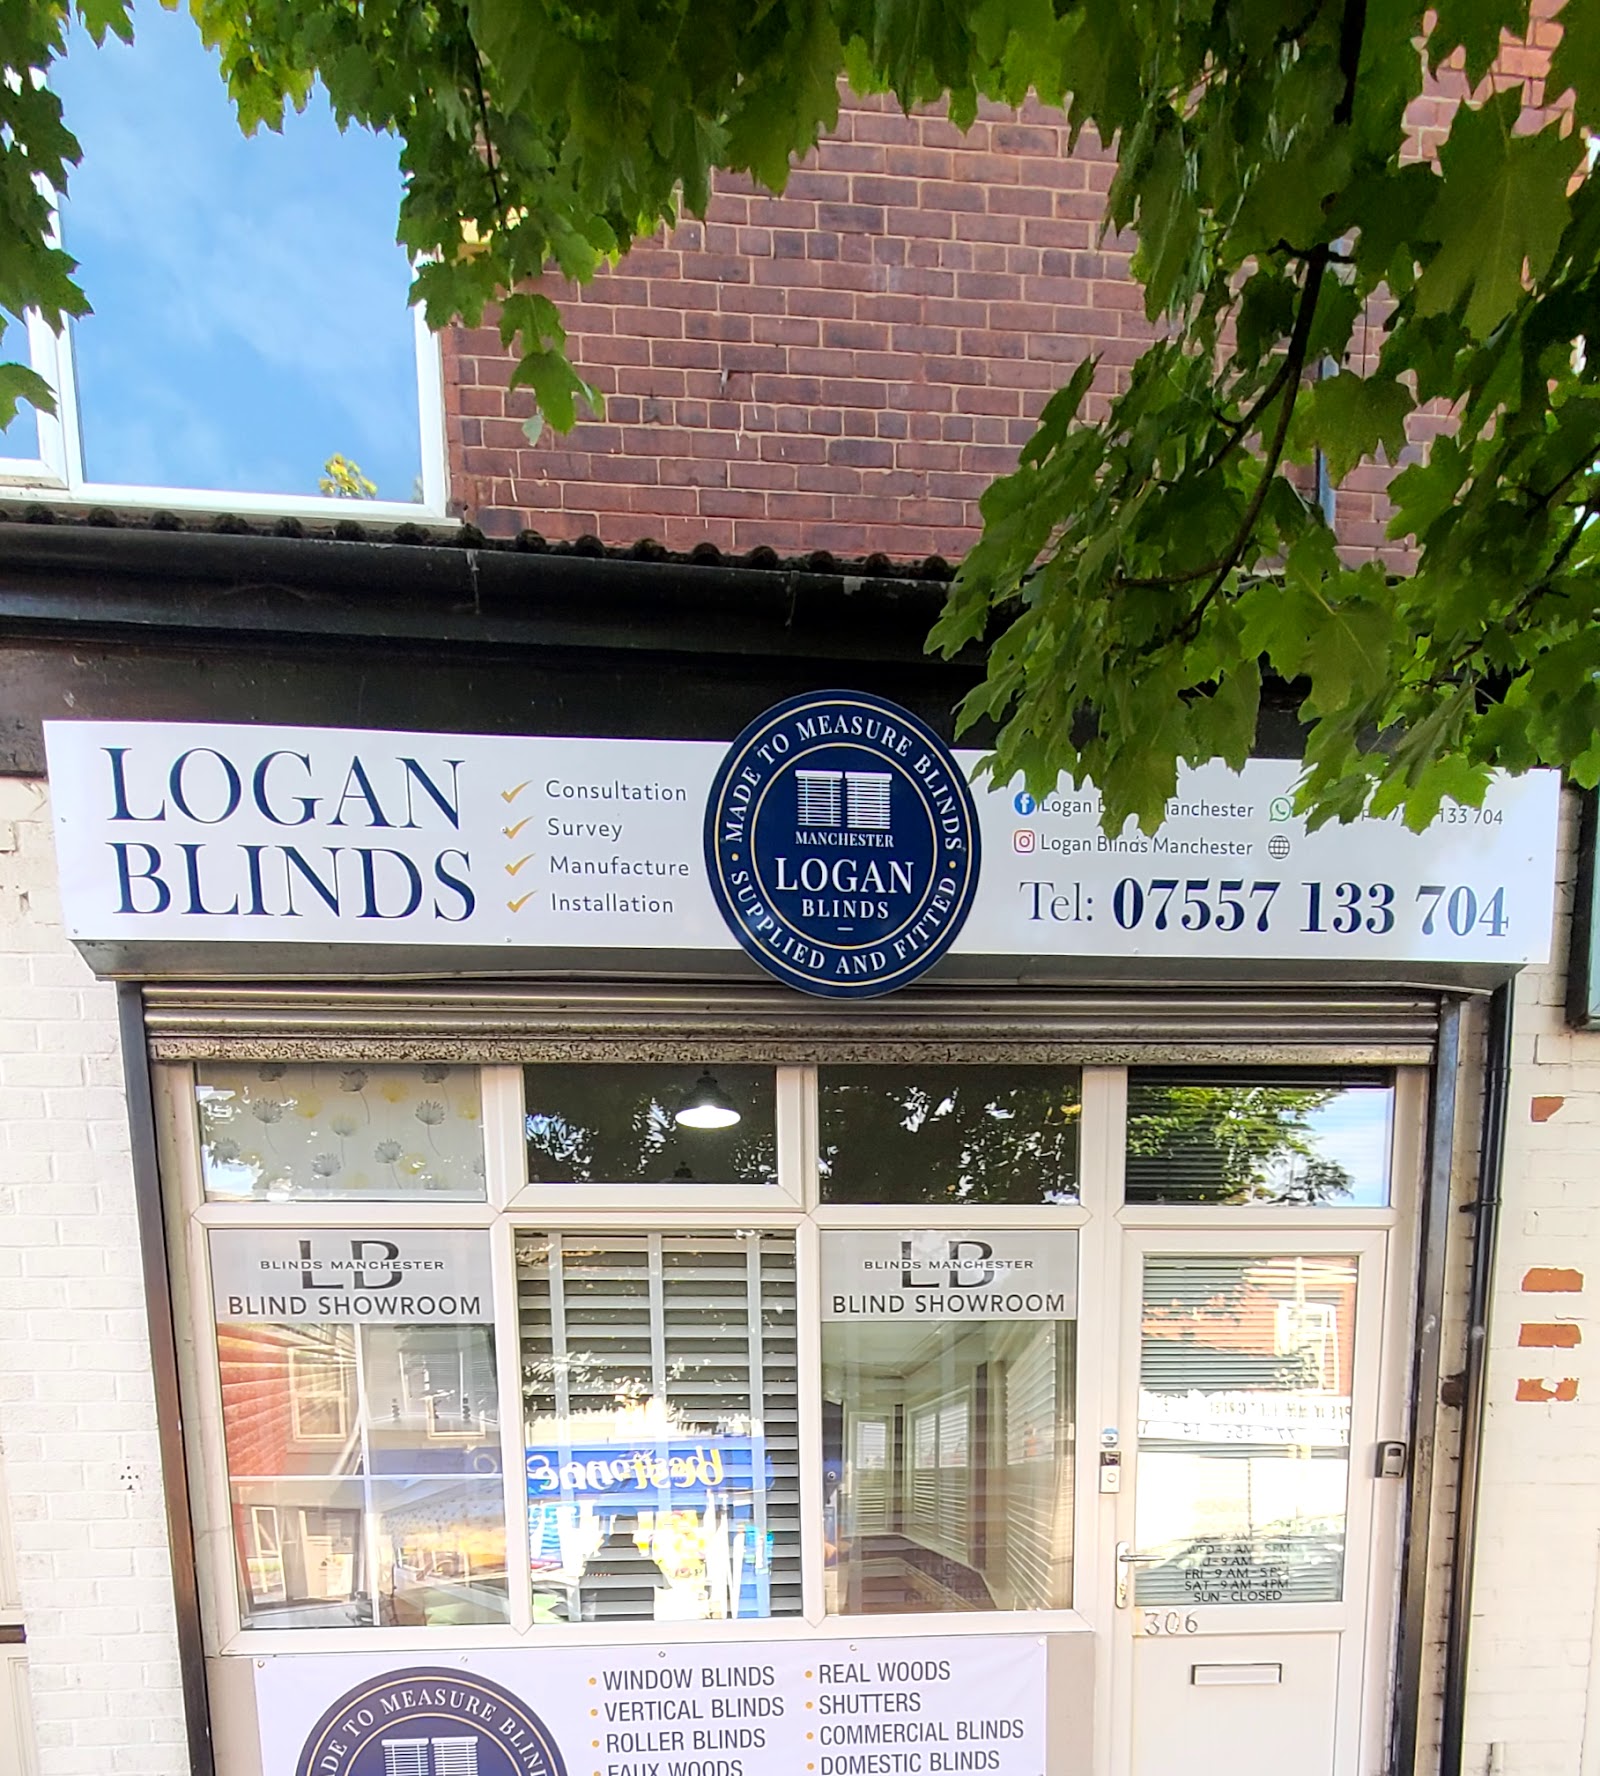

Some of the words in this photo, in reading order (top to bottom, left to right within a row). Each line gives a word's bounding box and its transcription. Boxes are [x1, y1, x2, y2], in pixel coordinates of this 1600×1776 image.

[100, 747, 465, 830] LOGAN
[545, 779, 687, 802] Consultation
[725, 766, 761, 843] MADE
[757, 733, 790, 765] TO
[795, 714, 912, 757] MEASURE
[913, 754, 962, 851] BLINDS
[1041, 799, 1091, 817] Logan
[1166, 799, 1254, 818] anchester
[1440, 807, 1467, 824] 133
[1473, 808, 1503, 824] 704
[547, 818, 623, 841] Survey
[795, 831, 894, 848] MANCHESTER
[1041, 834, 1091, 855] Logan
[1153, 837, 1253, 855] Manchester
[549, 855, 690, 877] Manufacture
[775, 857, 914, 894] LOGAN
[105, 841, 476, 922] BLINDS
[550, 893, 673, 914] Installation
[802, 899, 889, 919] BLINDS
[1019, 881, 1094, 922] Tel:
[1113, 877, 1280, 932] 07557
[1299, 882, 1396, 935] 133
[1415, 885, 1509, 937] 704
[731, 871, 825, 970] SUPPLIED
[835, 952, 886, 975] AND
[893, 878, 956, 960] FITTED
[260, 1260, 322, 1270] BLINDS
[331, 1260, 444, 1271] MANCHESTER
[864, 1260, 921, 1270] BLINDS
[929, 1259, 1034, 1270] MANCHESTER
[229, 1295, 307, 1316] BLIND
[318, 1296, 481, 1317] SHOWROOM
[832, 1294, 905, 1314] BLIND
[915, 1293, 1066, 1314] SHOWROOM
[1194, 1592, 1219, 1602] SUN
[1231, 1590, 1282, 1602] CLOSED
[1144, 1610, 1199, 1635] 306
[602, 1668, 693, 1691] WINDOW
[701, 1665, 775, 1688] BLINDS
[818, 1662, 871, 1684] REAL
[877, 1660, 951, 1683] WOODS
[343, 1709, 374, 1738] TO
[380, 1688, 497, 1722] MEASURE
[604, 1699, 704, 1722] VERTICAL
[711, 1697, 785, 1719] BLINDS
[819, 1693, 921, 1715] SHUTTERS
[606, 1730, 685, 1753] ROLLER
[693, 1728, 766, 1751] BLINDS
[820, 1722, 949, 1745] COMMERCIAL
[955, 1719, 1025, 1741] BLINDS
[820, 1753, 922, 1776] DOMESTIC
[929, 1750, 1000, 1772] BLINDS
